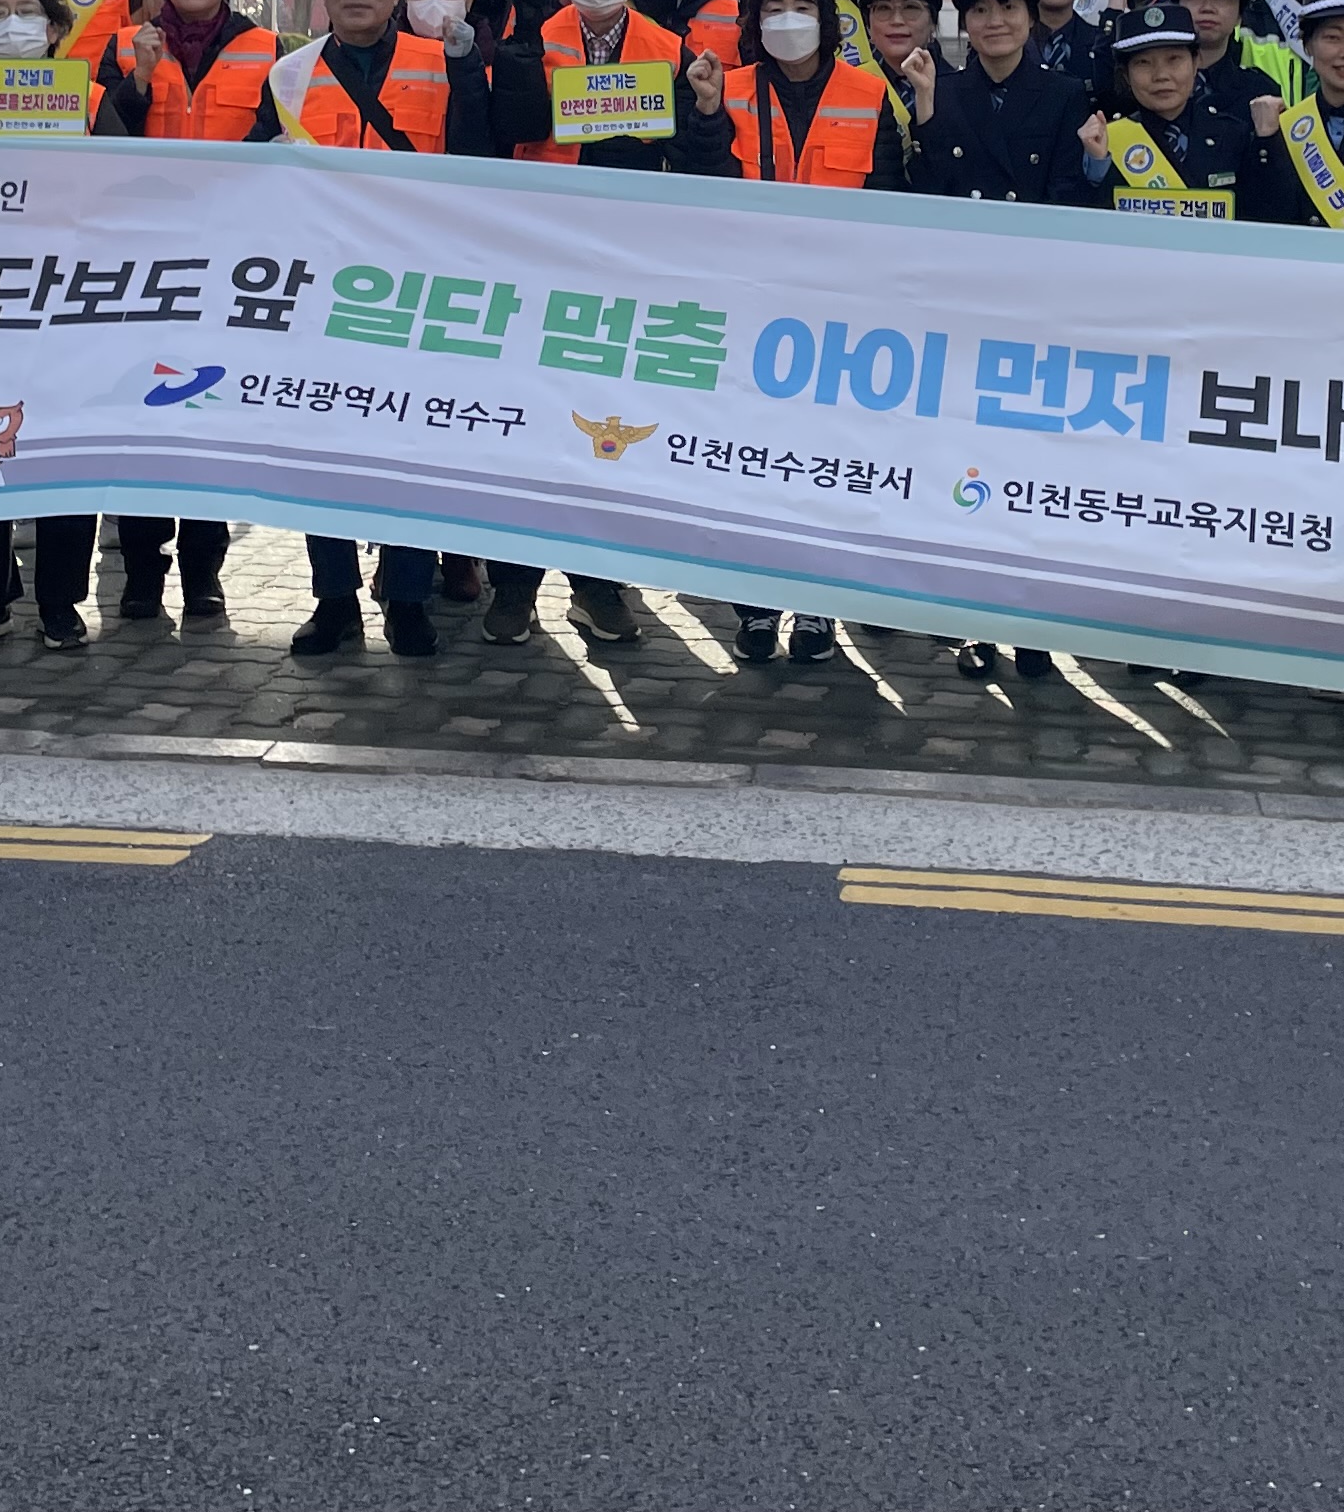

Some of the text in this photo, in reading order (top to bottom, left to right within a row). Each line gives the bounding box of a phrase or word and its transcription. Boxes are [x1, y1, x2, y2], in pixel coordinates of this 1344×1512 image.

[4, 69, 15, 86] 길
[586, 73, 636, 92] 자전거는
[21, 93, 44, 111] 보지
[47, 94, 80, 111] 않아요
[560, 94, 665, 117] 안전한 곳에서 타요
[226, 256, 315, 333] 앞
[324, 264, 523, 360] 일단
[537, 286, 729, 392] 멈춤
[752, 316, 950, 418] 아이
[973, 338, 1173, 445] 먼저
[238, 374, 528, 438] 인천광역시 연수구
[666, 431, 915, 500] 인천연수경찰서
[1000, 476, 1336, 555] 인천동부교육지원청
